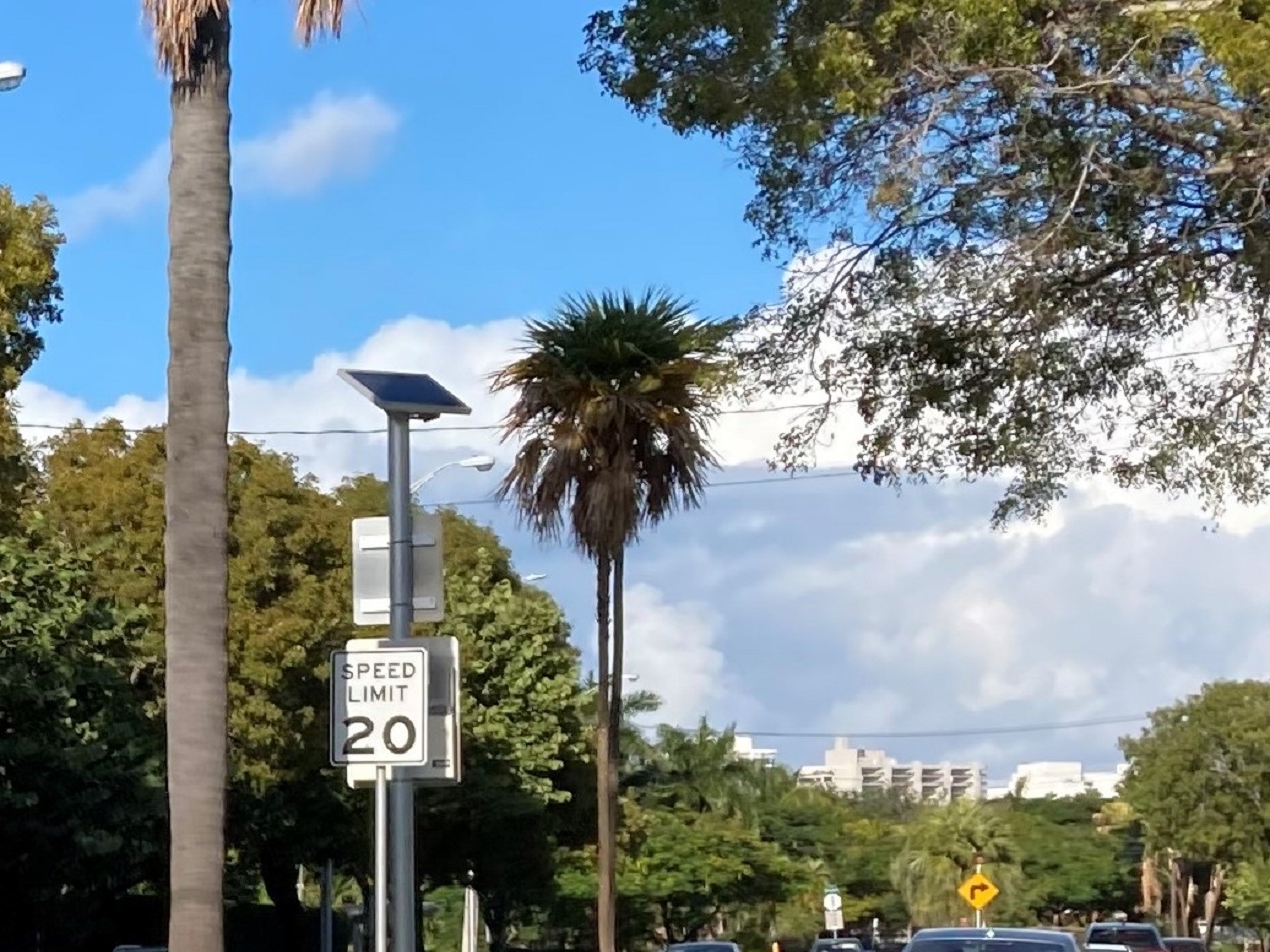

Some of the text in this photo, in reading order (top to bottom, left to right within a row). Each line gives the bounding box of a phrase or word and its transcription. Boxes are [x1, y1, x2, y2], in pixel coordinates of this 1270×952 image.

[341, 662, 416, 680] SPEED
[348, 685, 408, 702] LIMIT
[342, 715, 416, 755] 20
